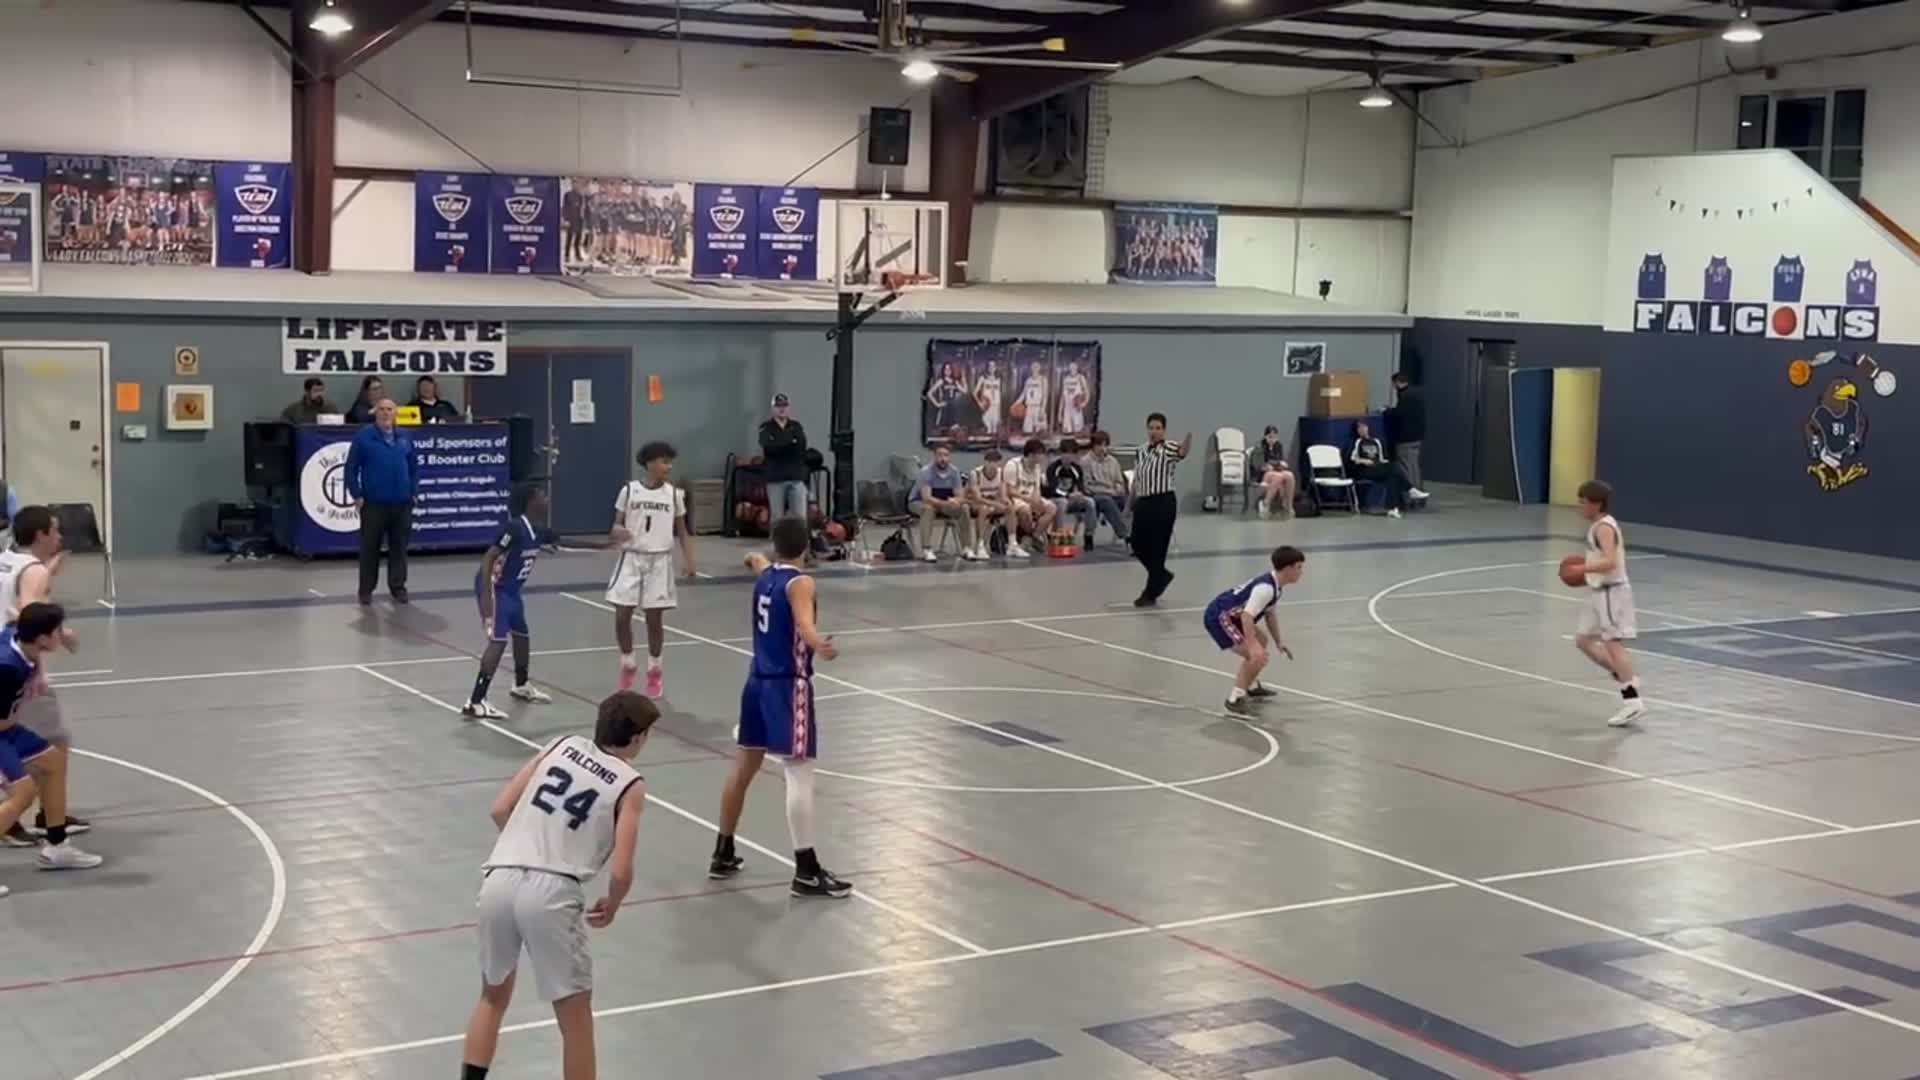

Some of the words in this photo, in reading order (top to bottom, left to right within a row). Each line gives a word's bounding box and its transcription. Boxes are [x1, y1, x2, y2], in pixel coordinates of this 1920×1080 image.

[286, 317, 503, 341] LIFEGATE
[295, 349, 496, 372] FALCONS
[436, 437, 492, 450] Sponsors
[494, 436, 507, 447] of
[428, 454, 475, 465] Booster
[477, 452, 506, 463] Club
[645, 515, 652, 533] 1
[757, 594, 772, 633] 5
[561, 746, 618, 785] FALCONS
[531, 766, 599, 831] 24
